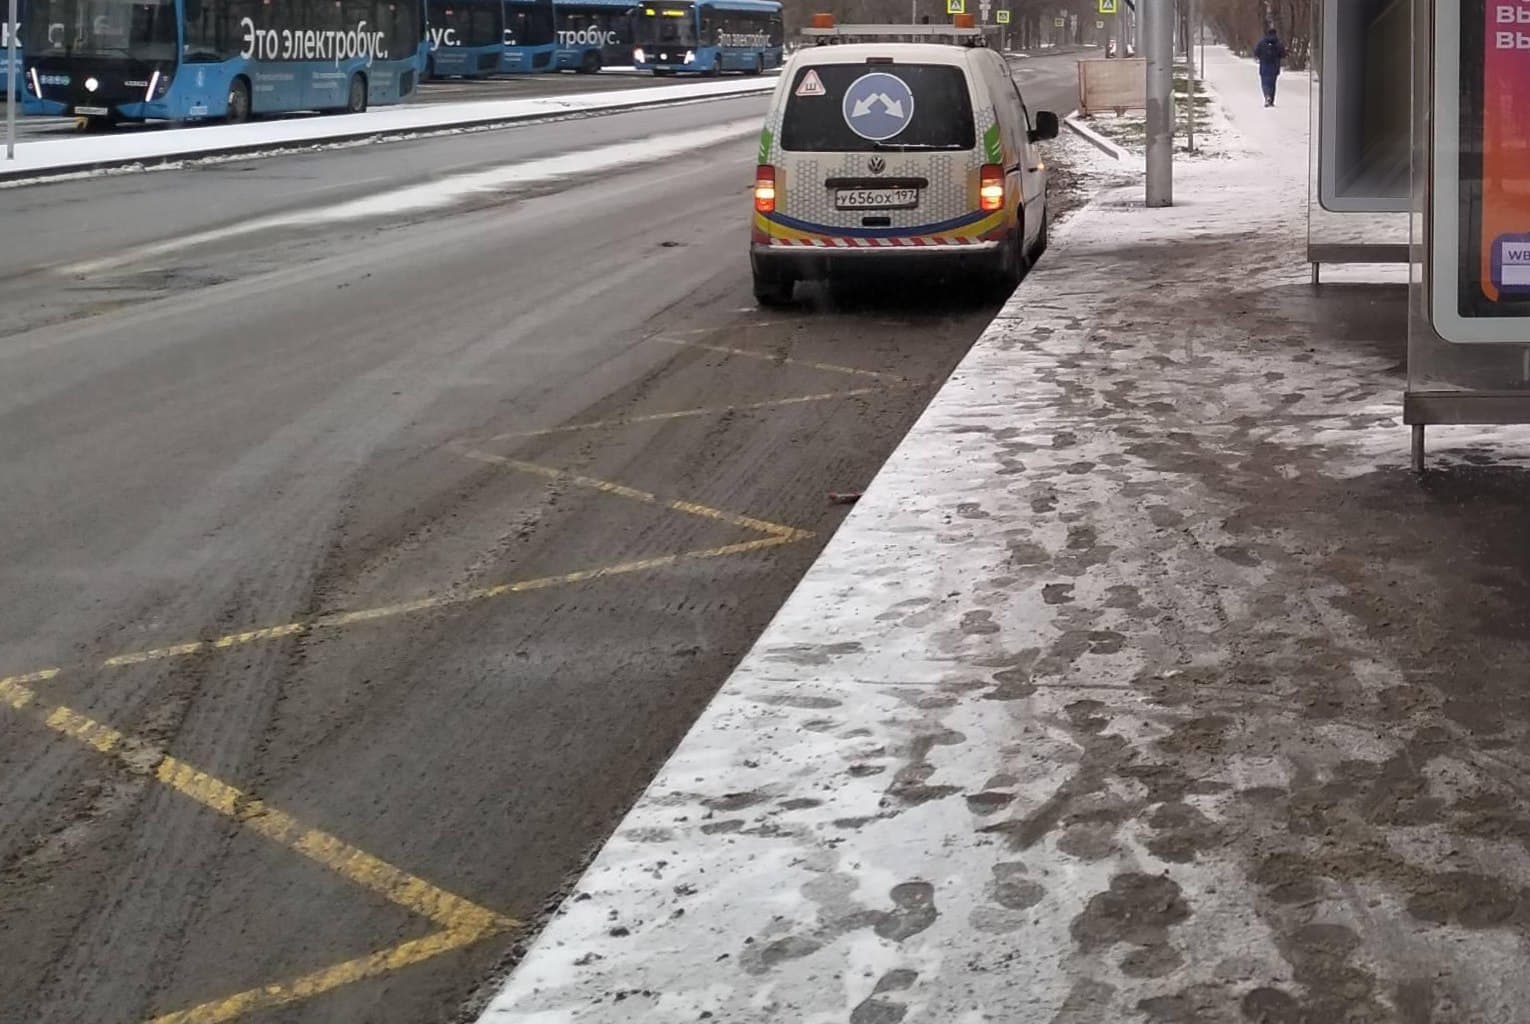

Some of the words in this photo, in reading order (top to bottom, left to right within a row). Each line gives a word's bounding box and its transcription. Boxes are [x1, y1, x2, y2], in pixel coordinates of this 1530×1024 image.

[240, 17, 279, 60] Это
[282, 20, 389, 68] электробус.
[895, 190, 914, 201] 197
